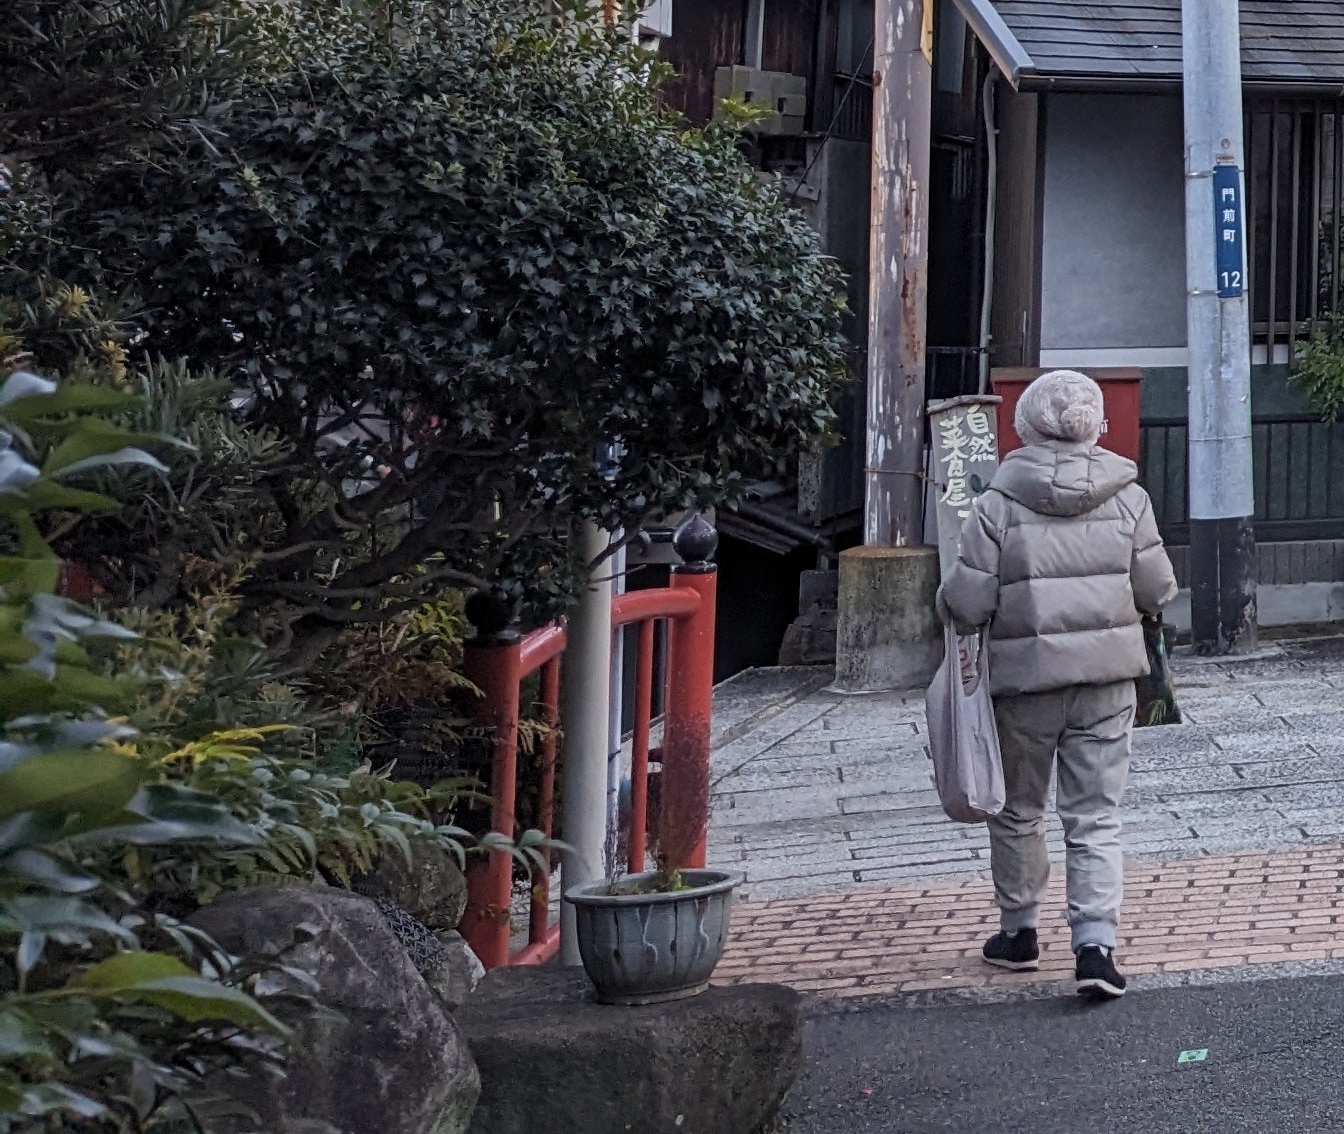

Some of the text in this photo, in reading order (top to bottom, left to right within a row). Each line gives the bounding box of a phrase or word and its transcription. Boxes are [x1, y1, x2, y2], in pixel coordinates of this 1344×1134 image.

[1221, 187, 1241, 288] 門前町 12
[939, 416, 971, 507] 菜食屋
[966, 404, 996, 462] 自然
